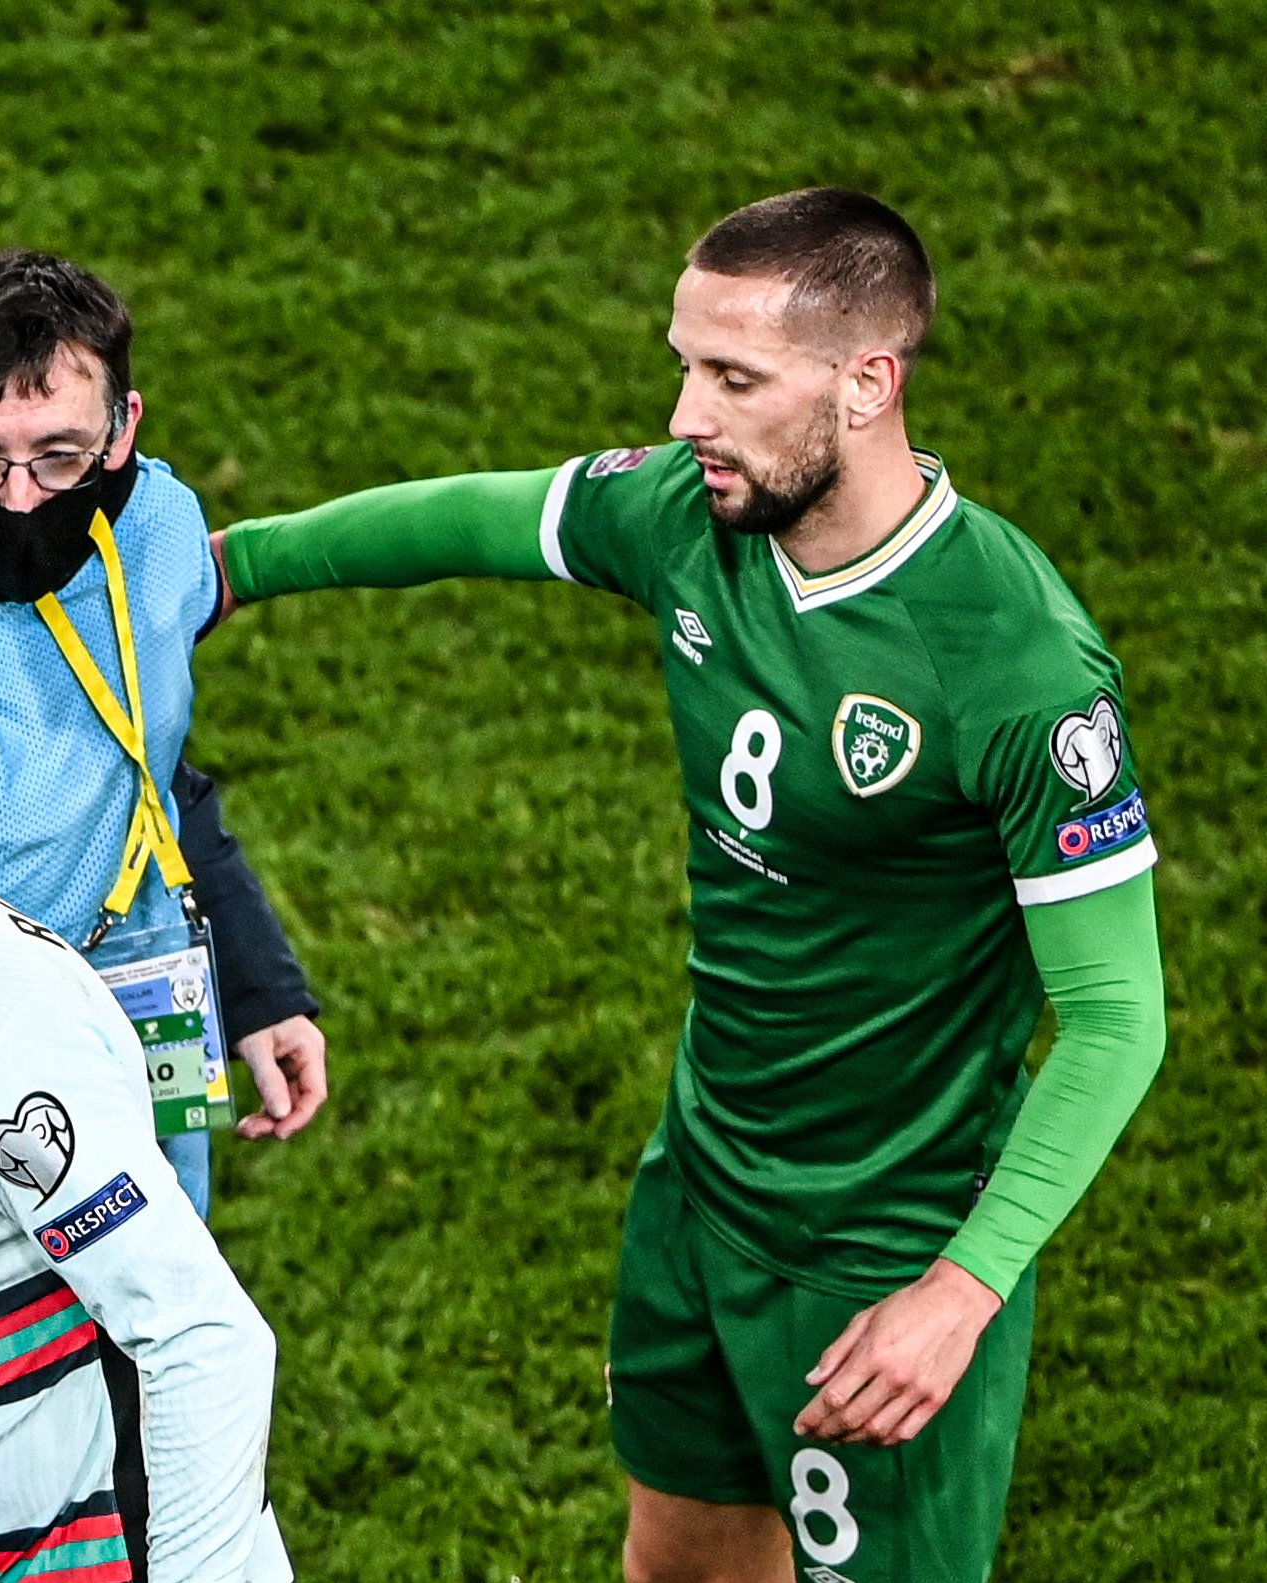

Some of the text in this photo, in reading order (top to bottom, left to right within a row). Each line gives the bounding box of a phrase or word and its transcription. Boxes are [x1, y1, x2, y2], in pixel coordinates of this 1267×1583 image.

[854, 704, 905, 741] Ireland
[720, 709, 783, 831] 8
[64, 1181, 139, 1242] RESPECT
[790, 1447, 860, 1566] 8
